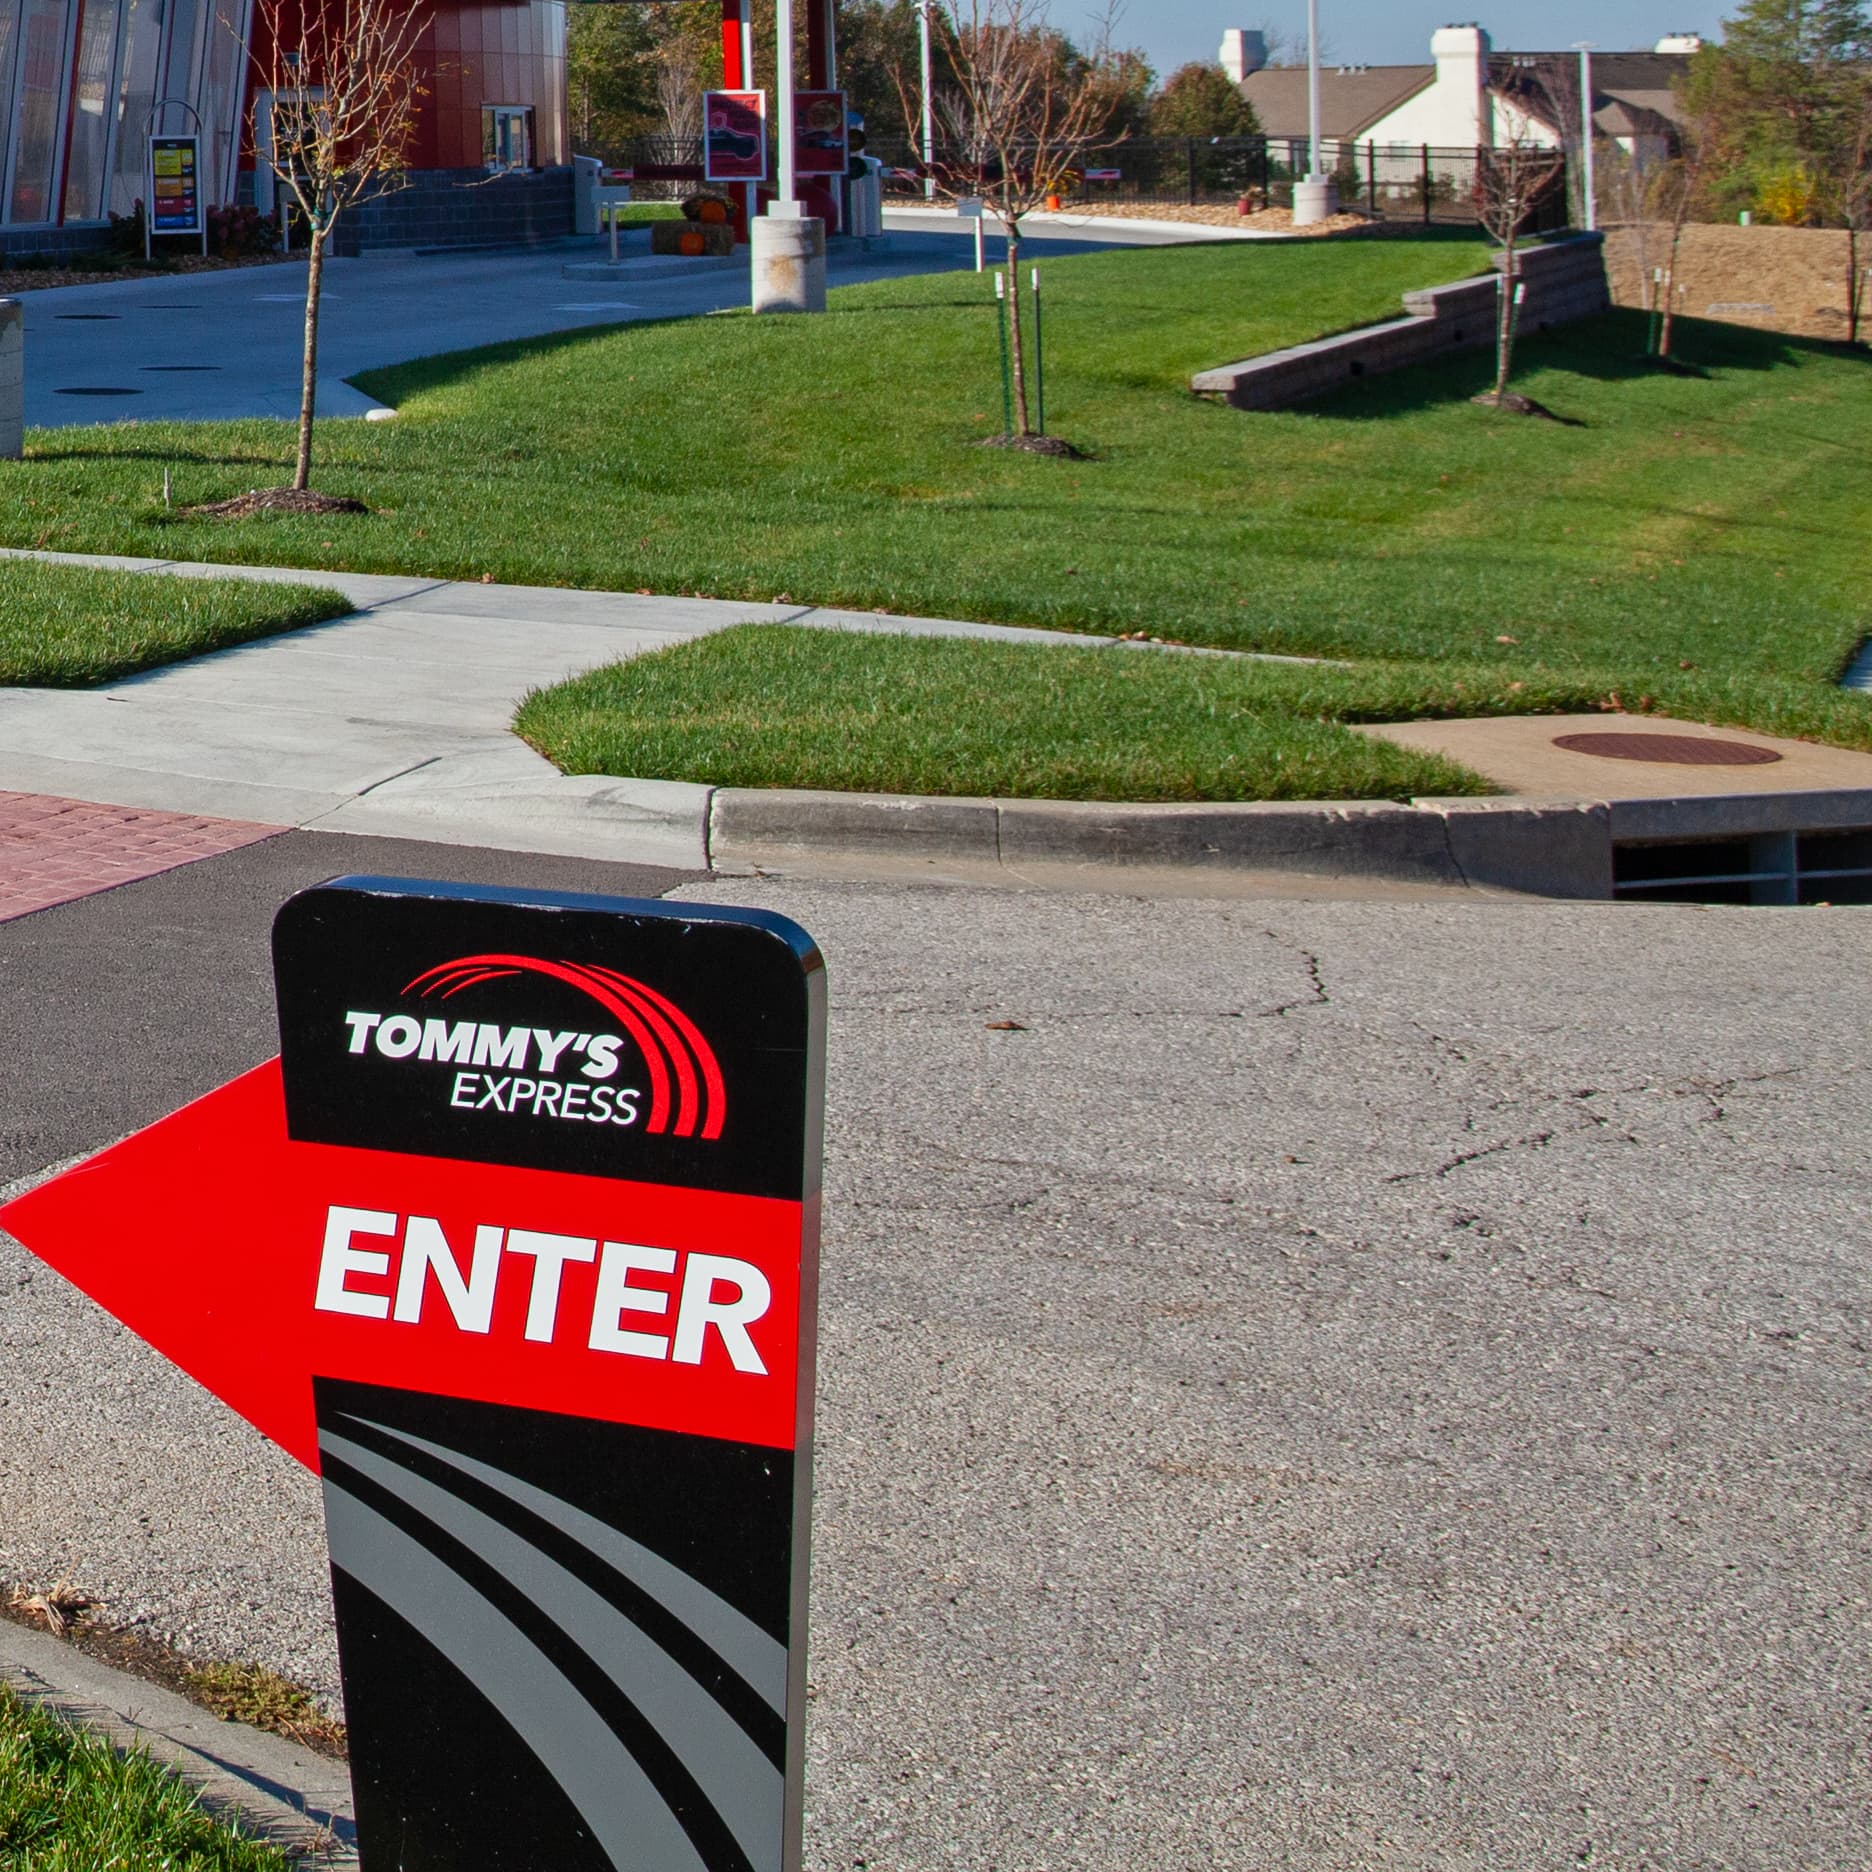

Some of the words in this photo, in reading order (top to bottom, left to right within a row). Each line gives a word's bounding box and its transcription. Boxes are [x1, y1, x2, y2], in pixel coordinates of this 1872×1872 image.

[345, 1011, 624, 1079] TOMMY'S
[450, 1072, 641, 1126] EXPRESS
[314, 1205, 772, 1376] ENTER
